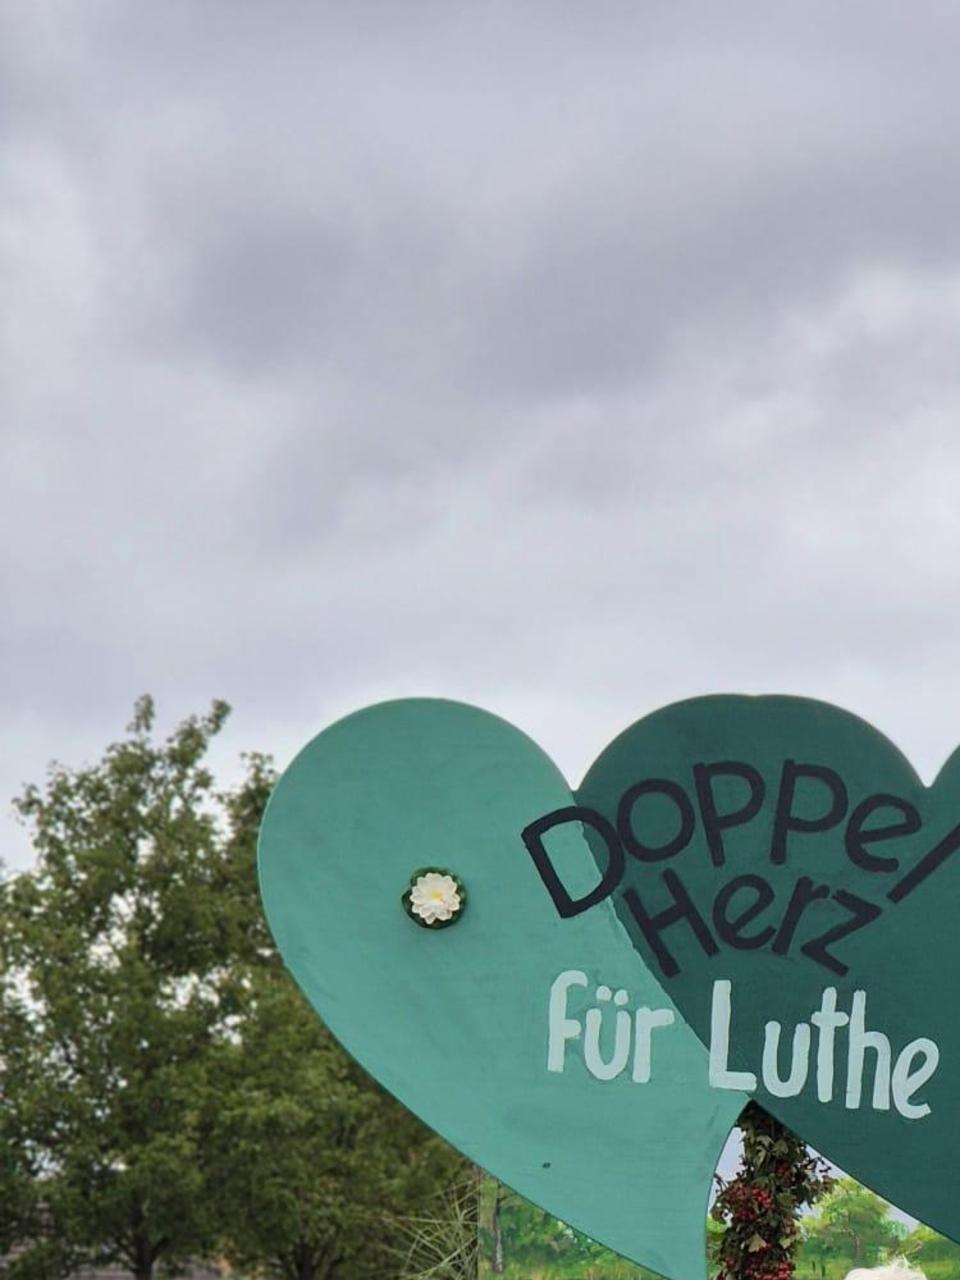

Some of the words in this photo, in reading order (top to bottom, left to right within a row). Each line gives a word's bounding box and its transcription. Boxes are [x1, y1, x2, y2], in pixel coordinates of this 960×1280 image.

[622, 868, 883, 978] Herz
[547, 969, 675, 1084] für
[708, 979, 940, 1120] Luthe
